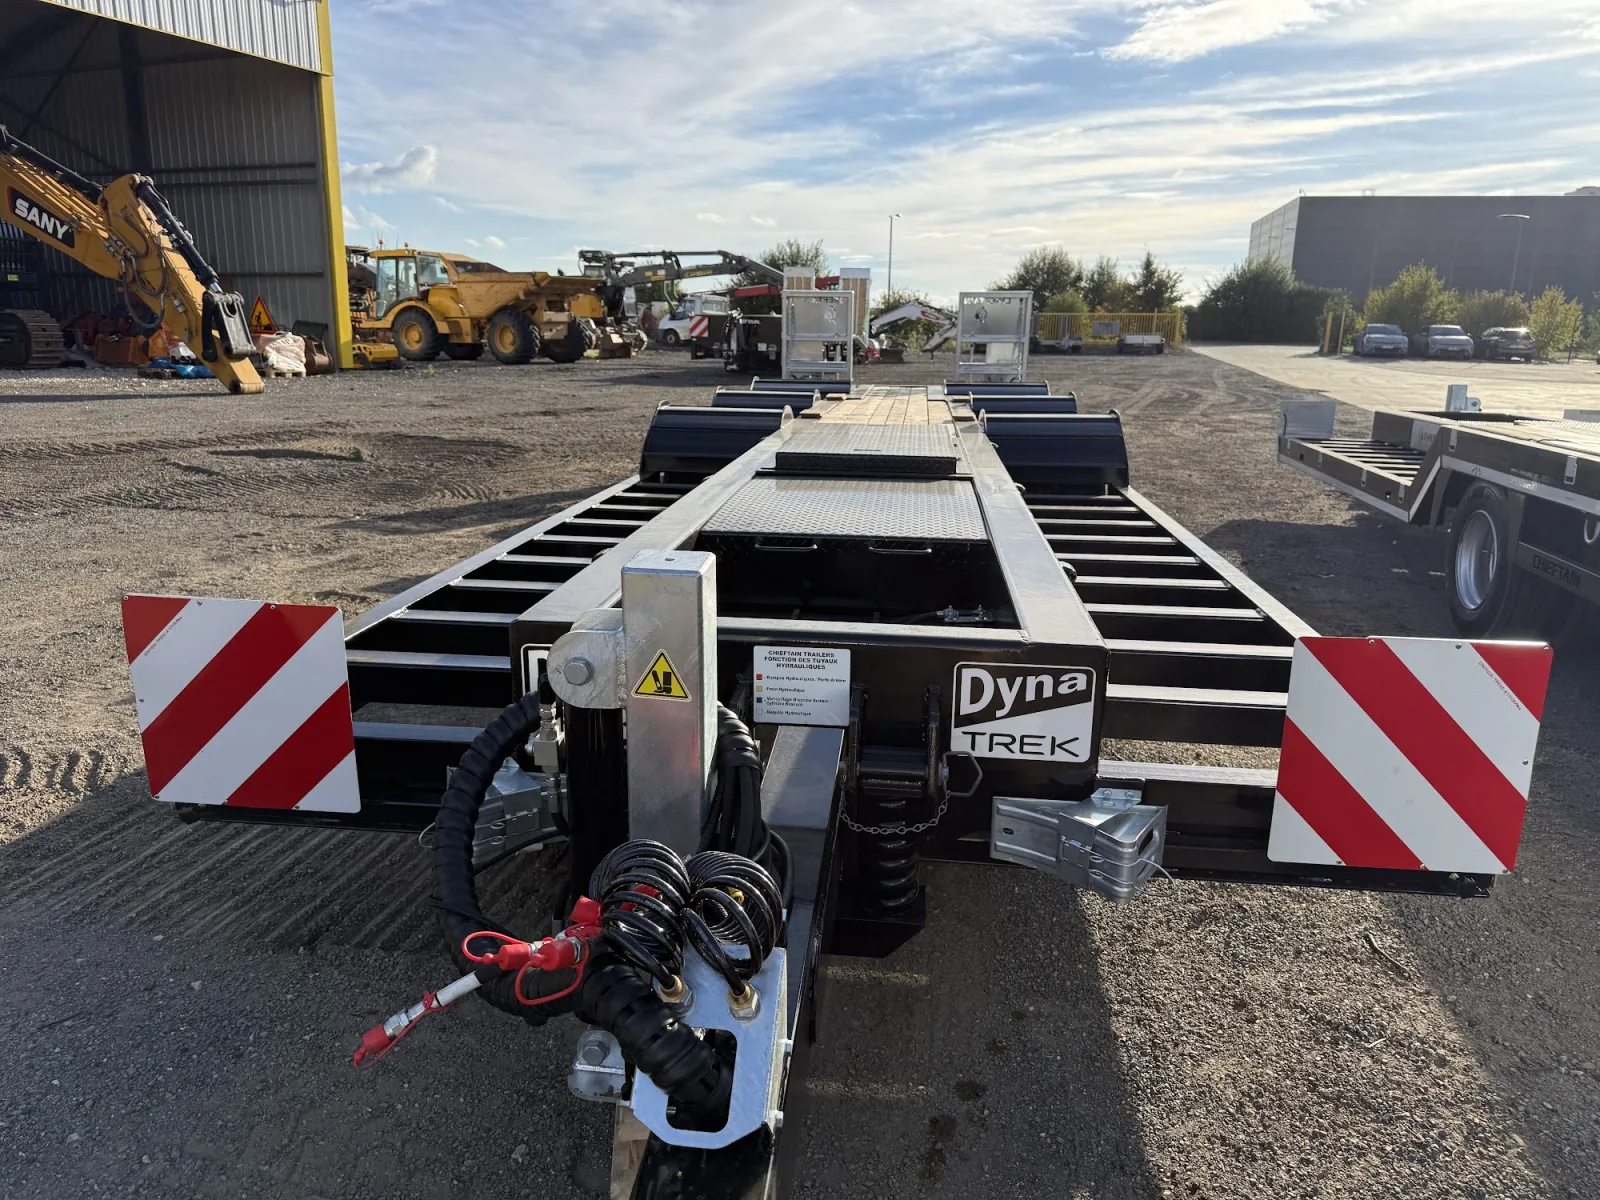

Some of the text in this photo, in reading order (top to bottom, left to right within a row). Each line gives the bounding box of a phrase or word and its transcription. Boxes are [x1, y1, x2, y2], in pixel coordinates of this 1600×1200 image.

[15, 198, 69, 240] SANY
[1532, 553, 1581, 588] CHIEFTAIN
[959, 667, 1088, 718] Dyna
[961, 731, 1080, 758] TREK
